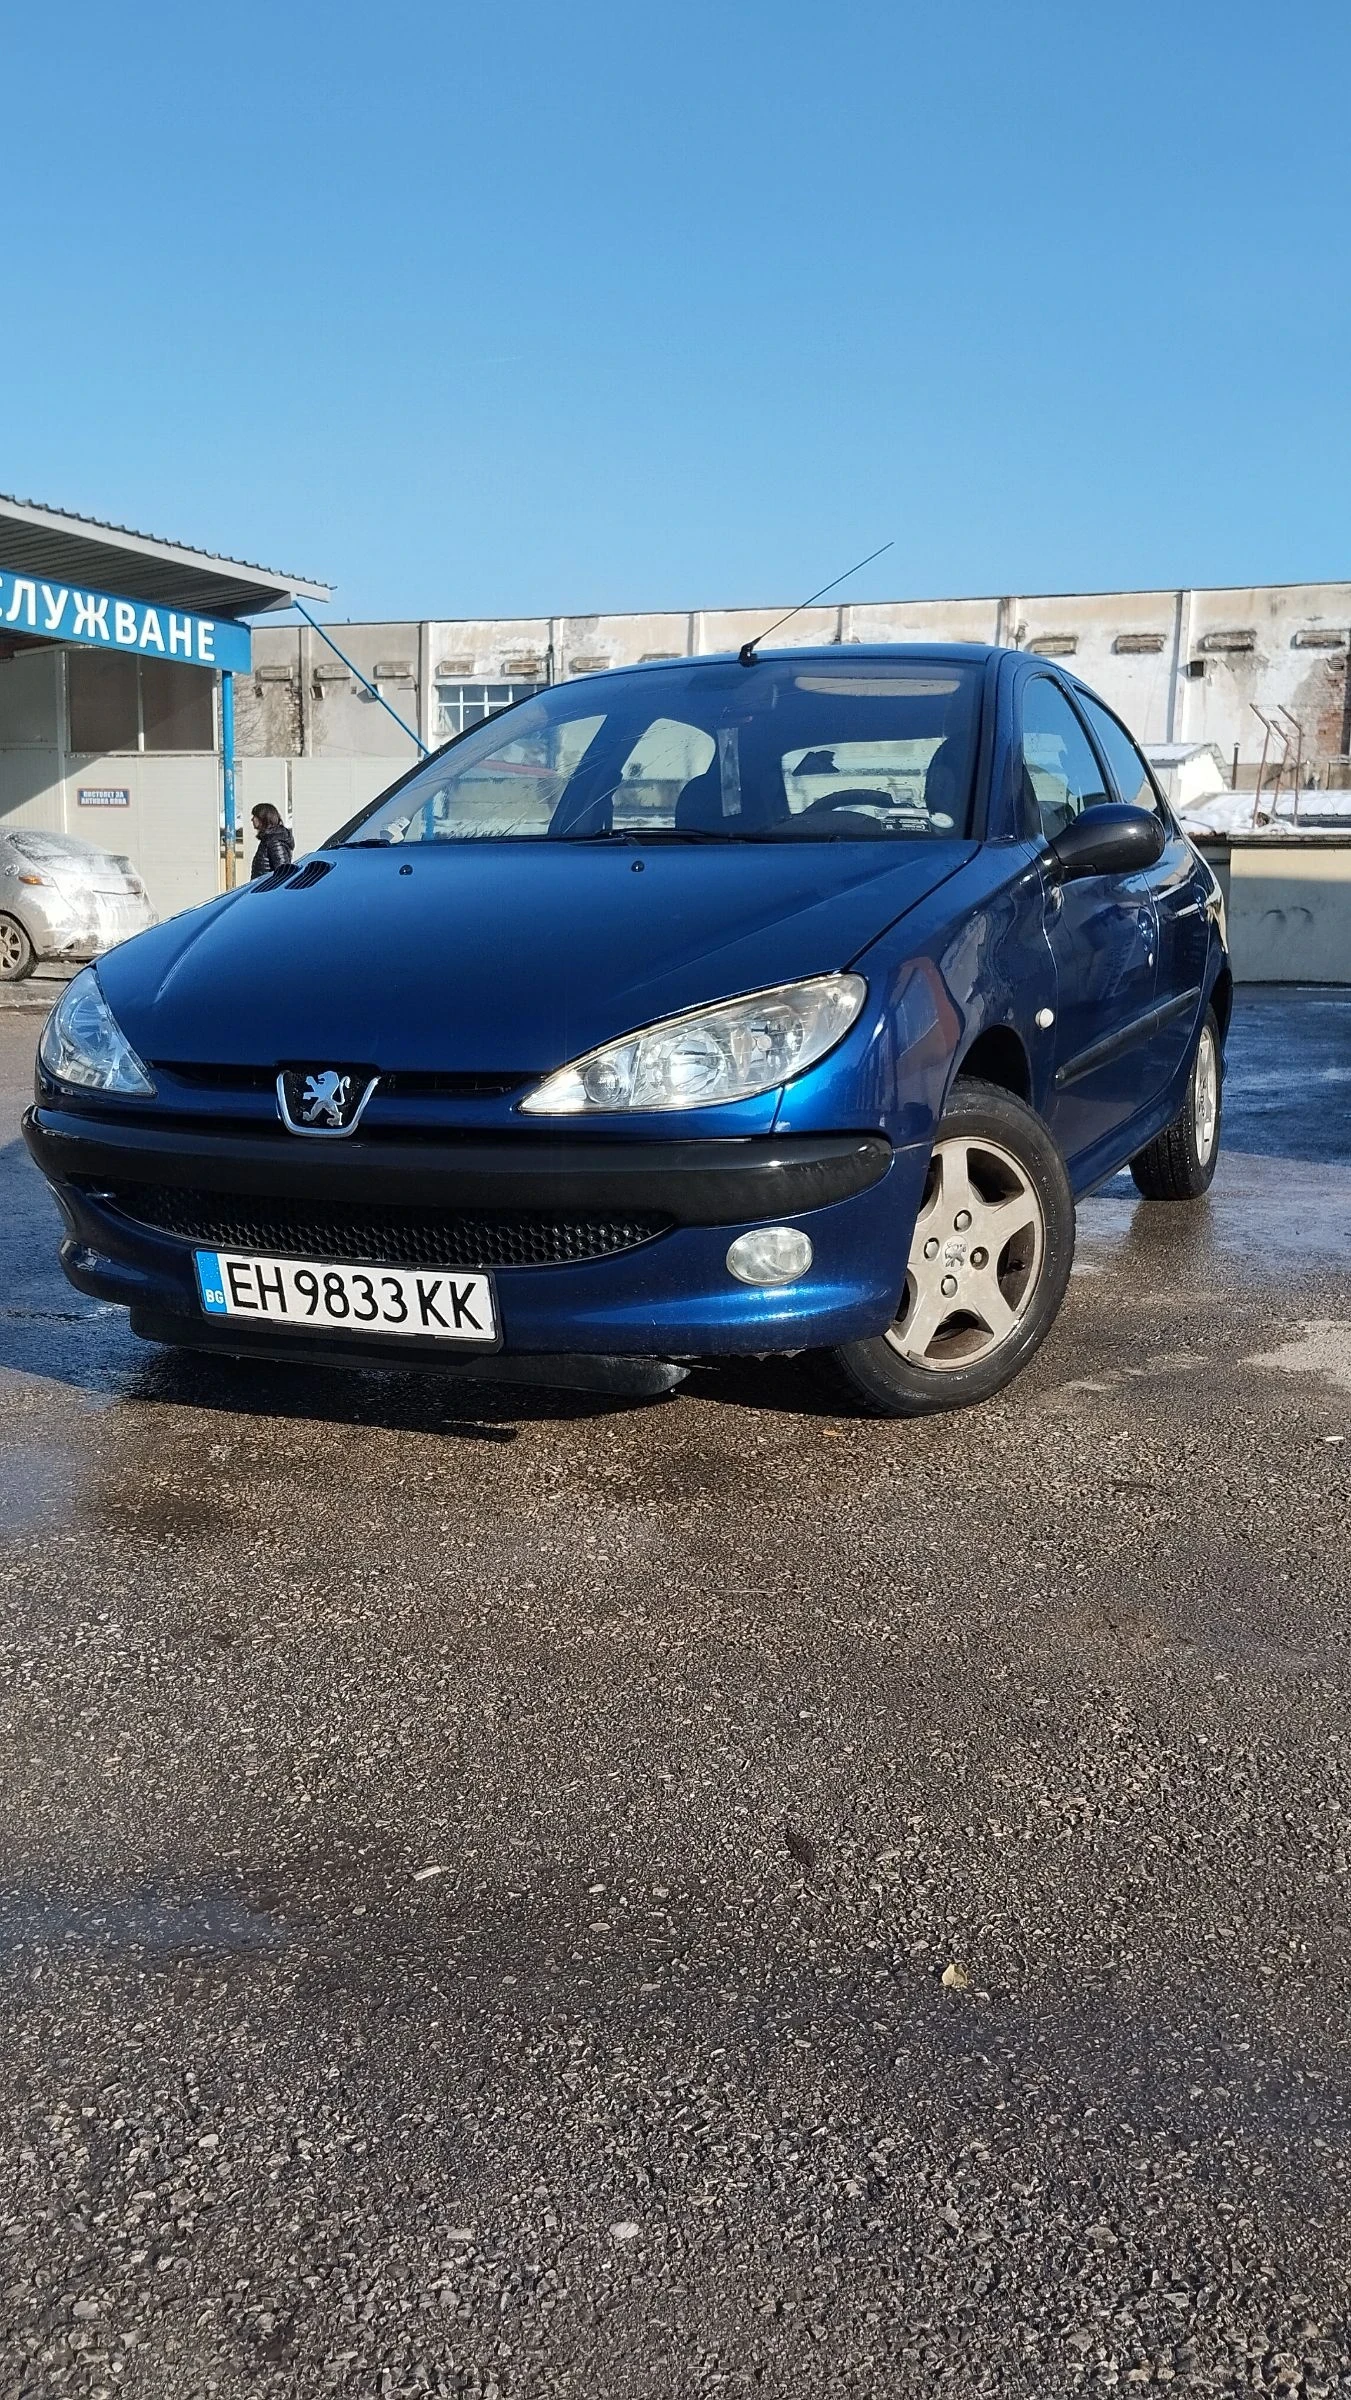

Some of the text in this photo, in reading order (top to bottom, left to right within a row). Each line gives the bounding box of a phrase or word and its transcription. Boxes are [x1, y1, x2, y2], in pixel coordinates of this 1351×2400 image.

[0, 575, 215, 662] ЛУЖВАНЕ
[205, 1288, 224, 1304] BG
[226, 1261, 484, 1330] EH 9833 KK
